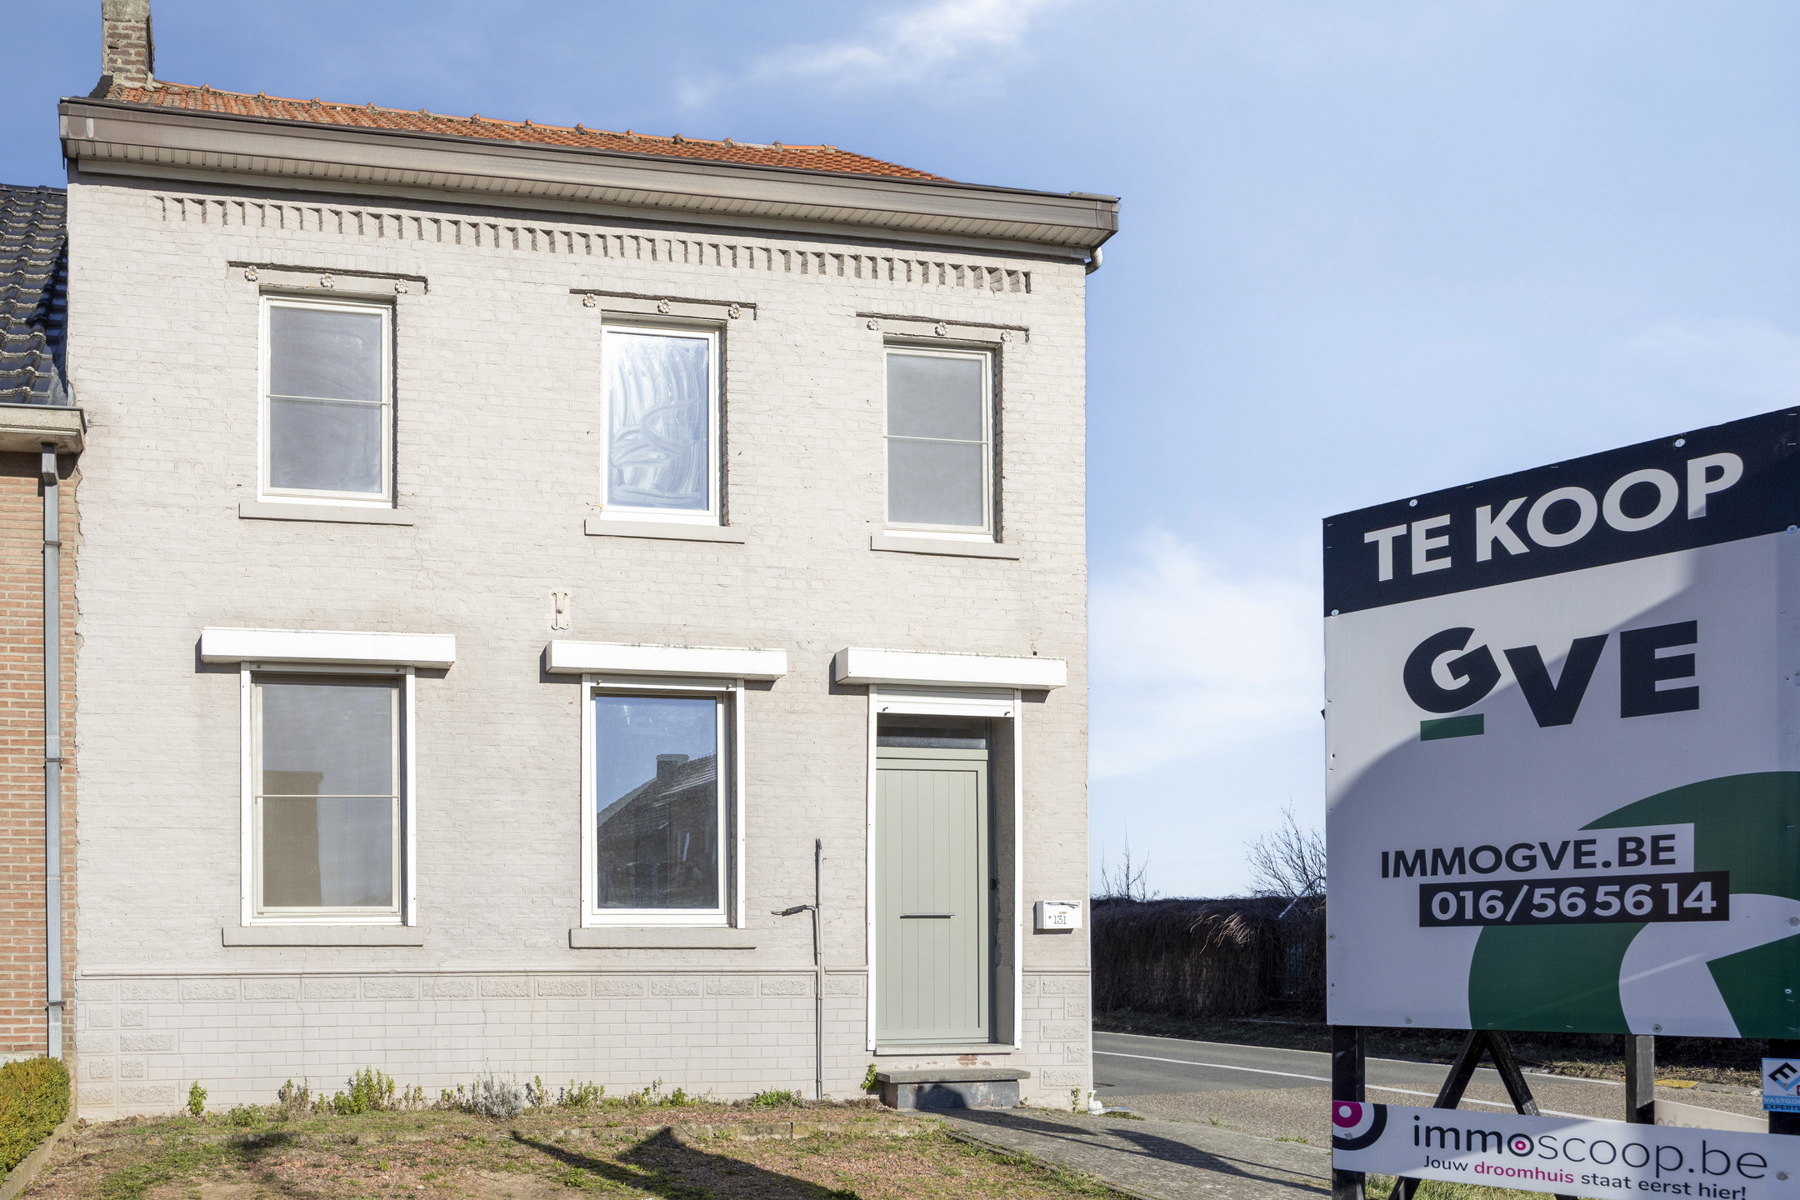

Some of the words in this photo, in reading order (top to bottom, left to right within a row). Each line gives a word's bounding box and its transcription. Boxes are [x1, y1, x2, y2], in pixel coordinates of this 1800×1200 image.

[1364, 513, 1452, 582] TE
[1475, 452, 1744, 563] KOOP
[1403, 619, 1700, 728] GVE
[1381, 833, 1677, 879] IMMOGVE.BE
[1053, 914, 1067, 925] 131
[1763, 1096, 1800, 1105] VASTGO
[1413, 1115, 1768, 1179] immoscoop.be
[1423, 1155, 1469, 1172] Jouw
[1474, 1161, 1574, 1184] droomhuis
[1580, 1172, 1632, 1190] staat
[1638, 1180, 1692, 1196] eerst
[1698, 1182, 1747, 1200] hier!
